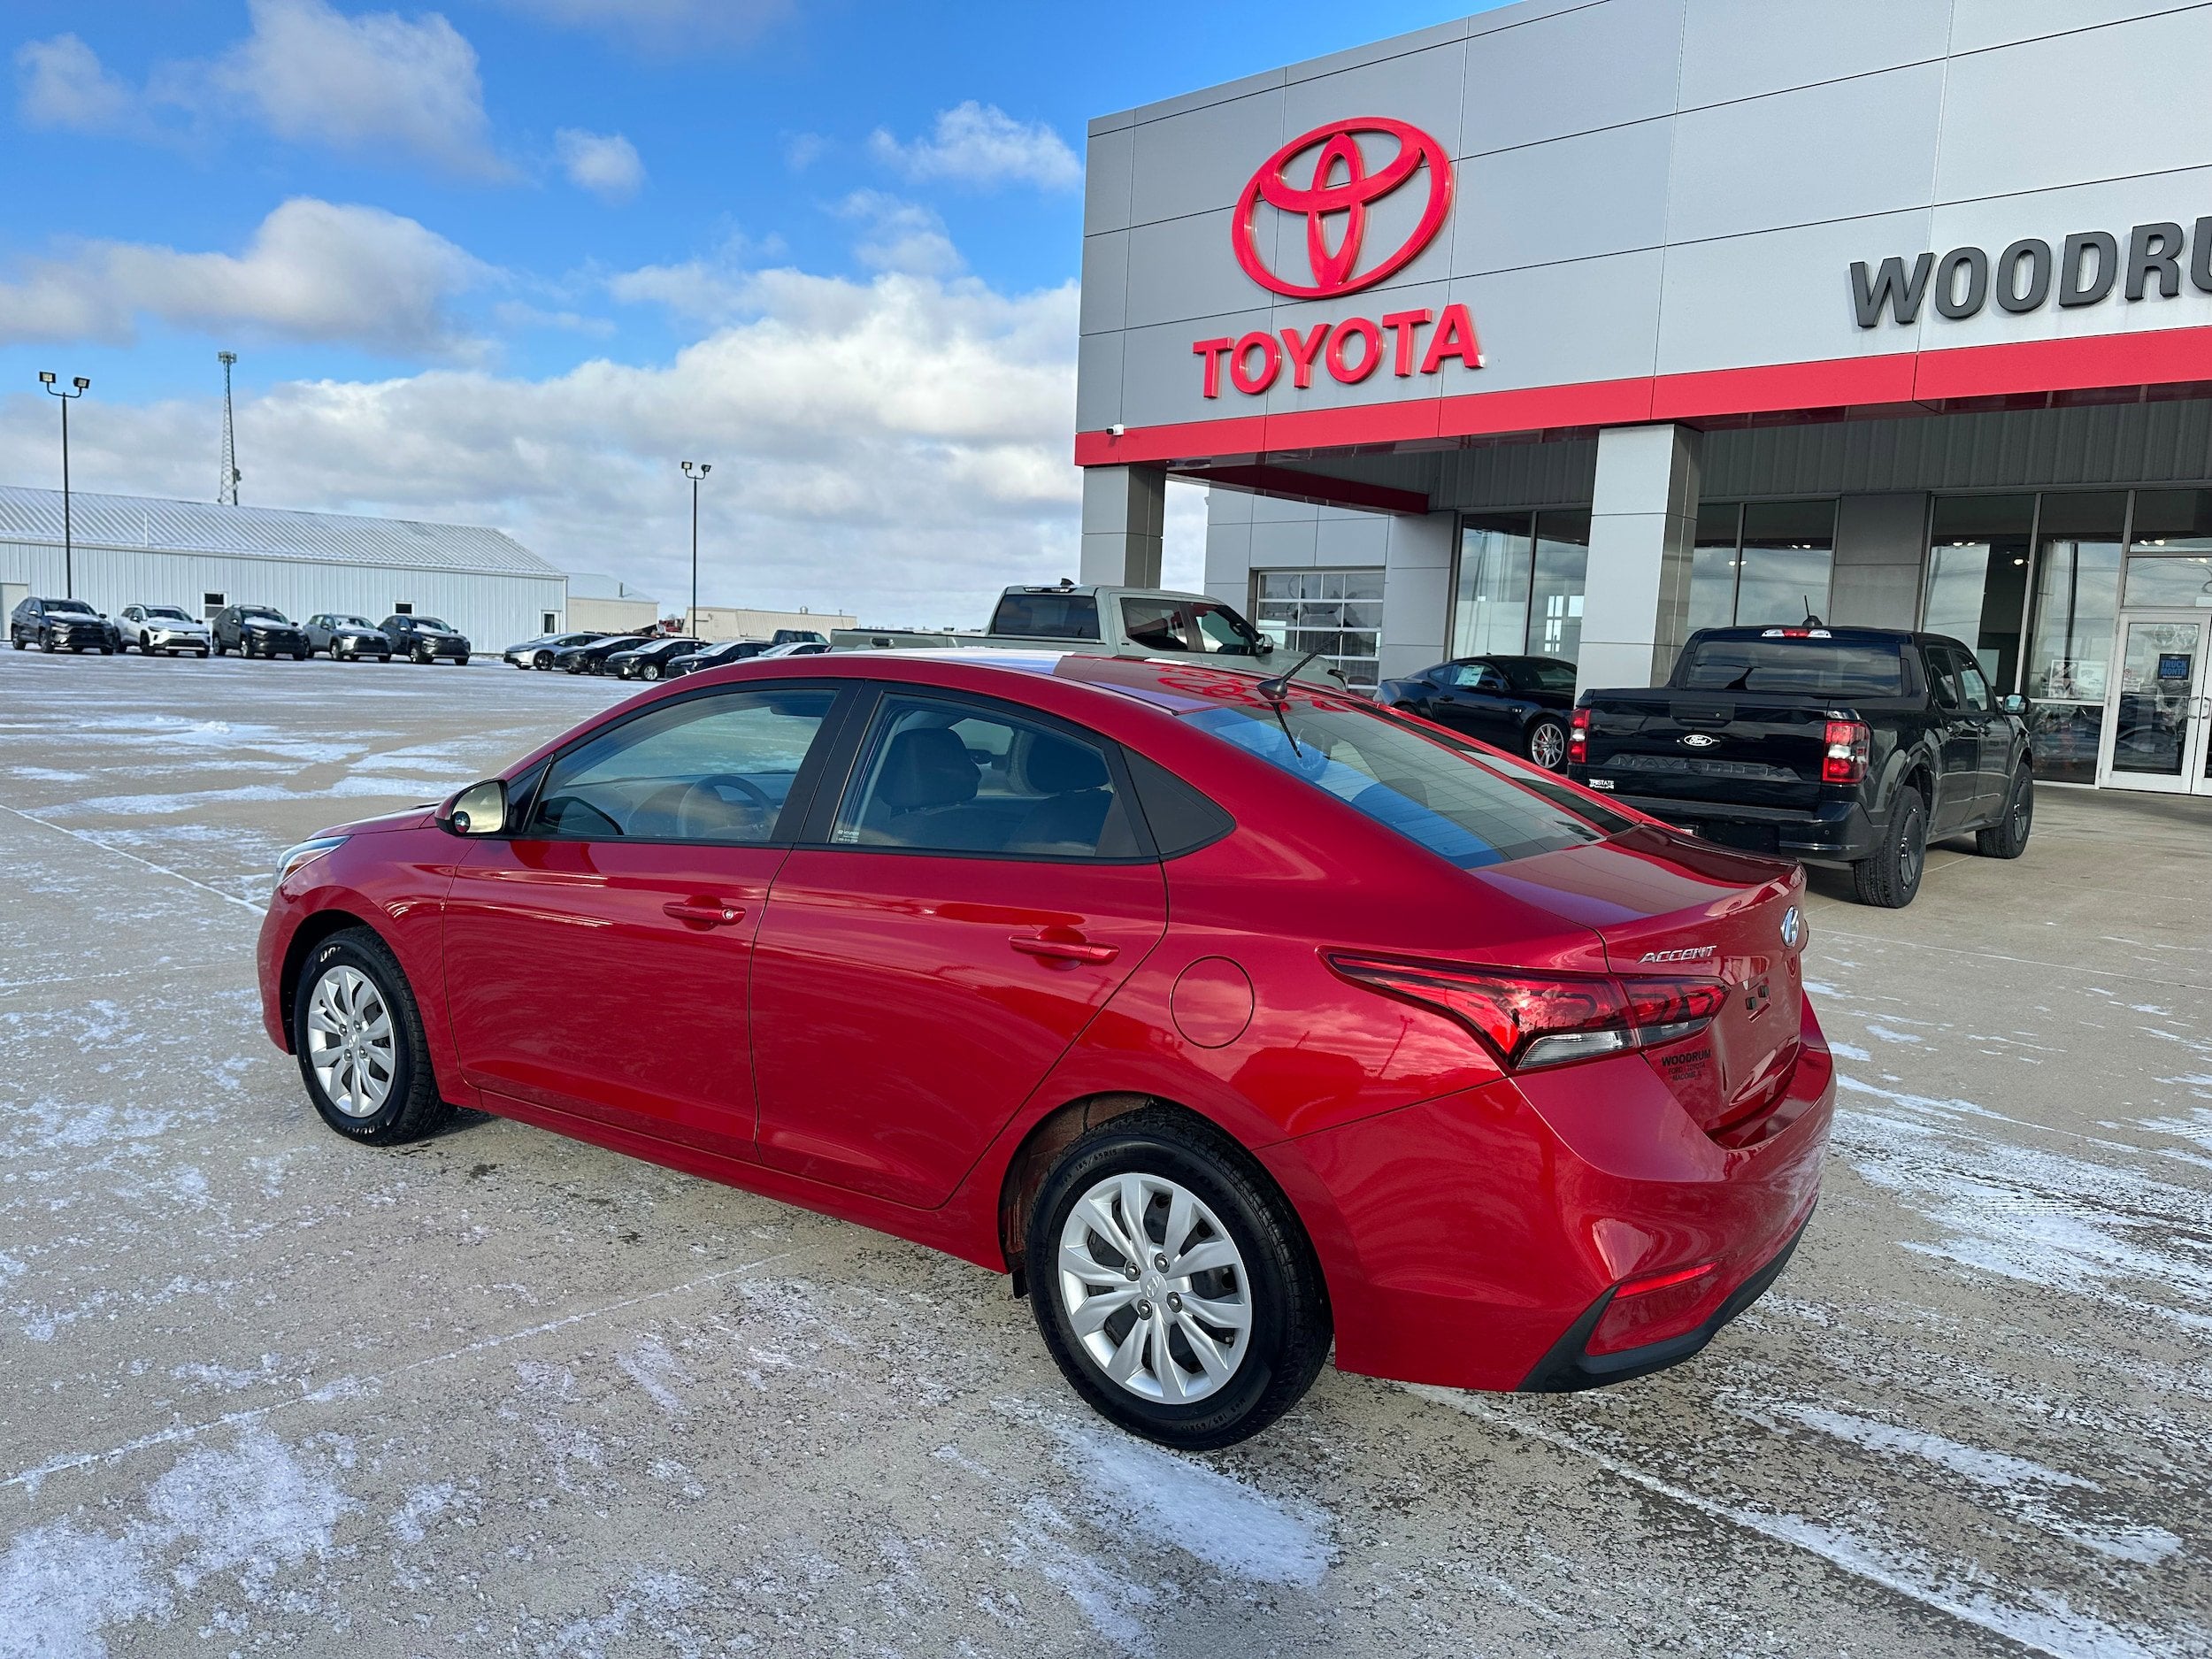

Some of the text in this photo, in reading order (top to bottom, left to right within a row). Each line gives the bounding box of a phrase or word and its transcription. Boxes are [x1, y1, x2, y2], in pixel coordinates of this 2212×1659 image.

[1193, 303, 1484, 398] TOYOTA
[2161, 659, 2188, 668] TRUCK
[1617, 756, 1785, 778] MAVERICK
[1637, 945, 1717, 964] ACCENT
[1661, 1048, 1711, 1066] WOODRUM
